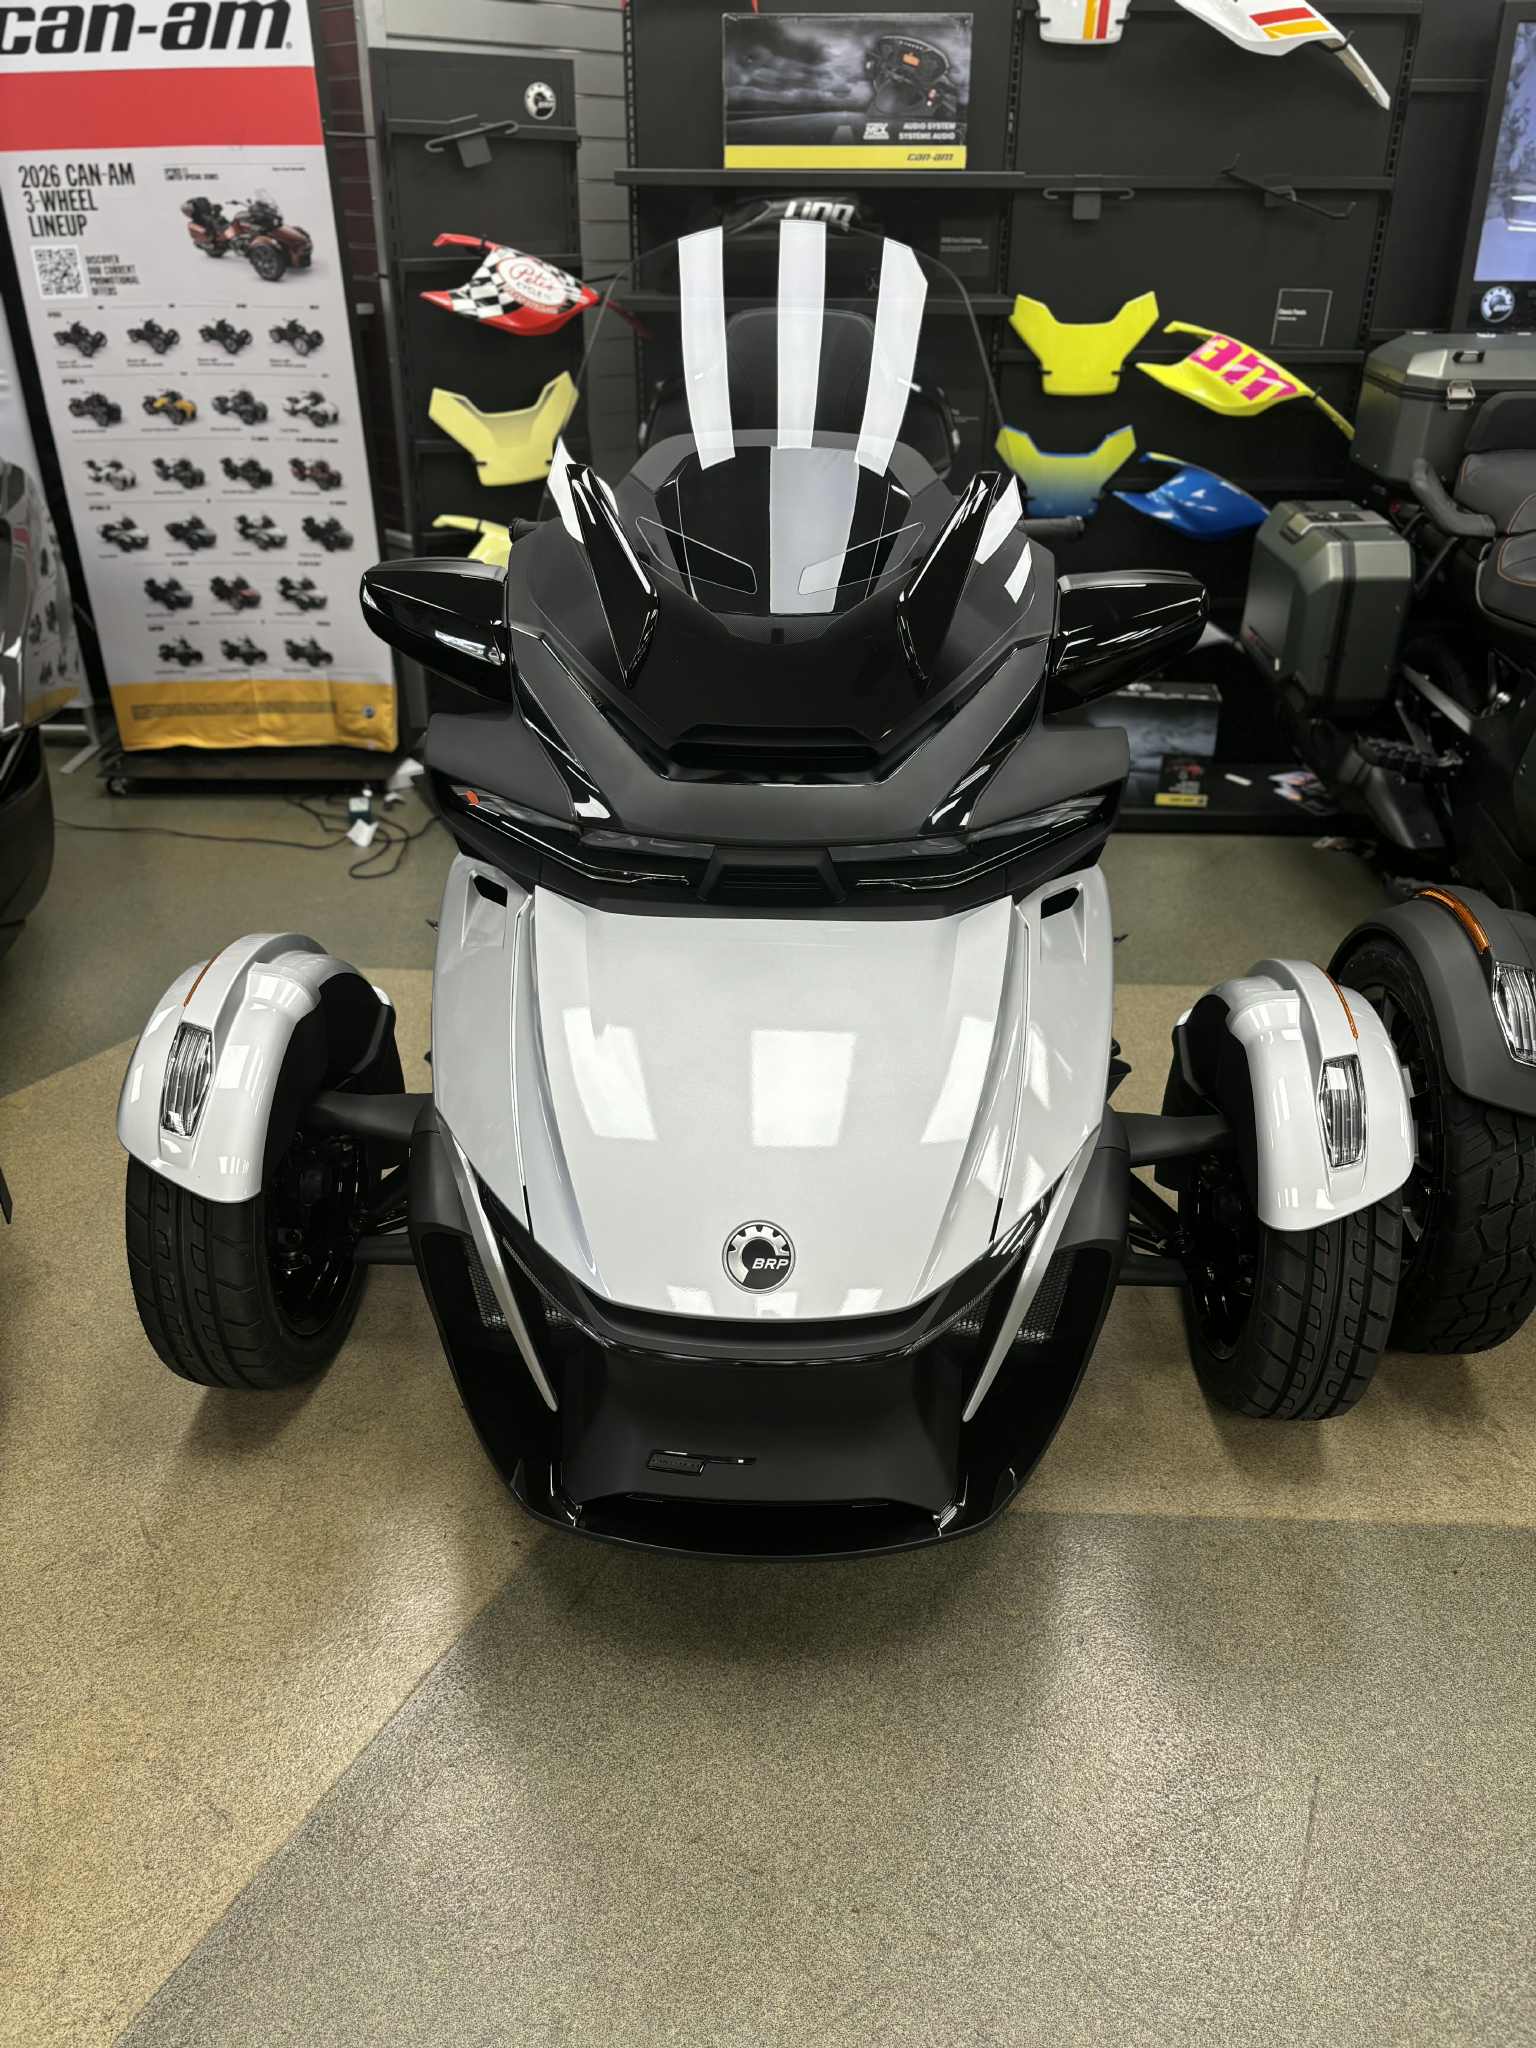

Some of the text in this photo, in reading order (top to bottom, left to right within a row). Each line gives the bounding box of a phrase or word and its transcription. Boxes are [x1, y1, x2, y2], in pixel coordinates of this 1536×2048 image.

[0, 0, 291, 54] can-am
[18, 162, 136, 188] 2026 CAN-AM
[24, 188, 99, 213] 3-WHEEL
[28, 213, 88, 237] LINEUP
[752, 1257, 789, 1270] BRP
